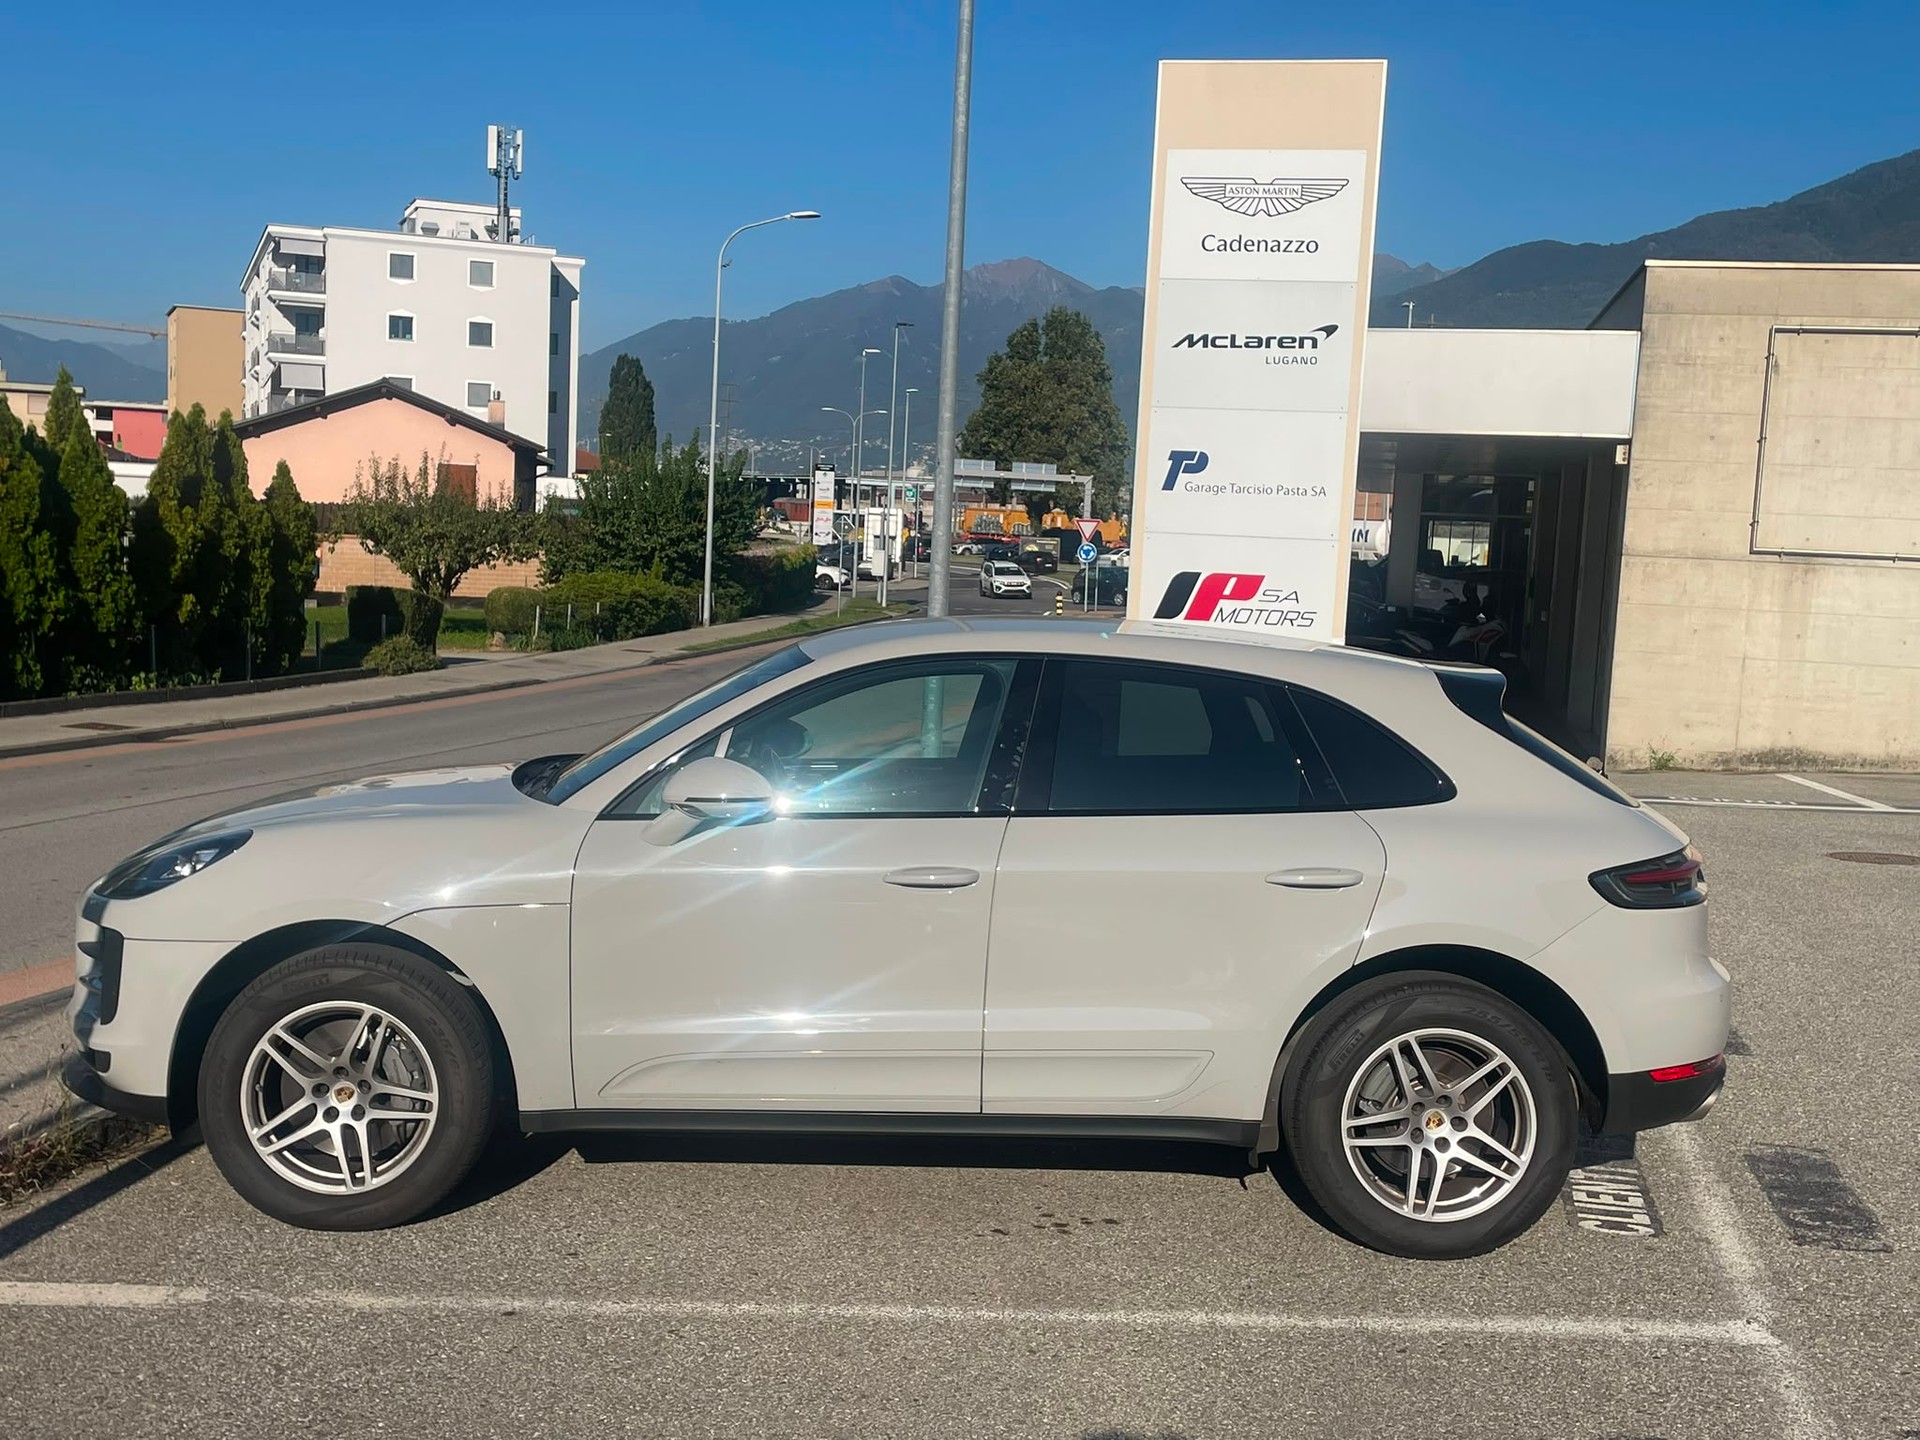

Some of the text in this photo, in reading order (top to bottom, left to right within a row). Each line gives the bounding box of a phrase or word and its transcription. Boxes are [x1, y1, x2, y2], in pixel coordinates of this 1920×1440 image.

[1227, 186, 1300, 197] ASTON MARTIN
[1201, 234, 1319, 254] Cadenazzo
[1171, 333, 1318, 349] McLaren
[1265, 355, 1318, 366] LUGANO
[1184, 480, 1327, 497] Garage Tarcisio Pasta SA
[1258, 589, 1300, 604] SA
[1214, 607, 1318, 628] MOTORS
